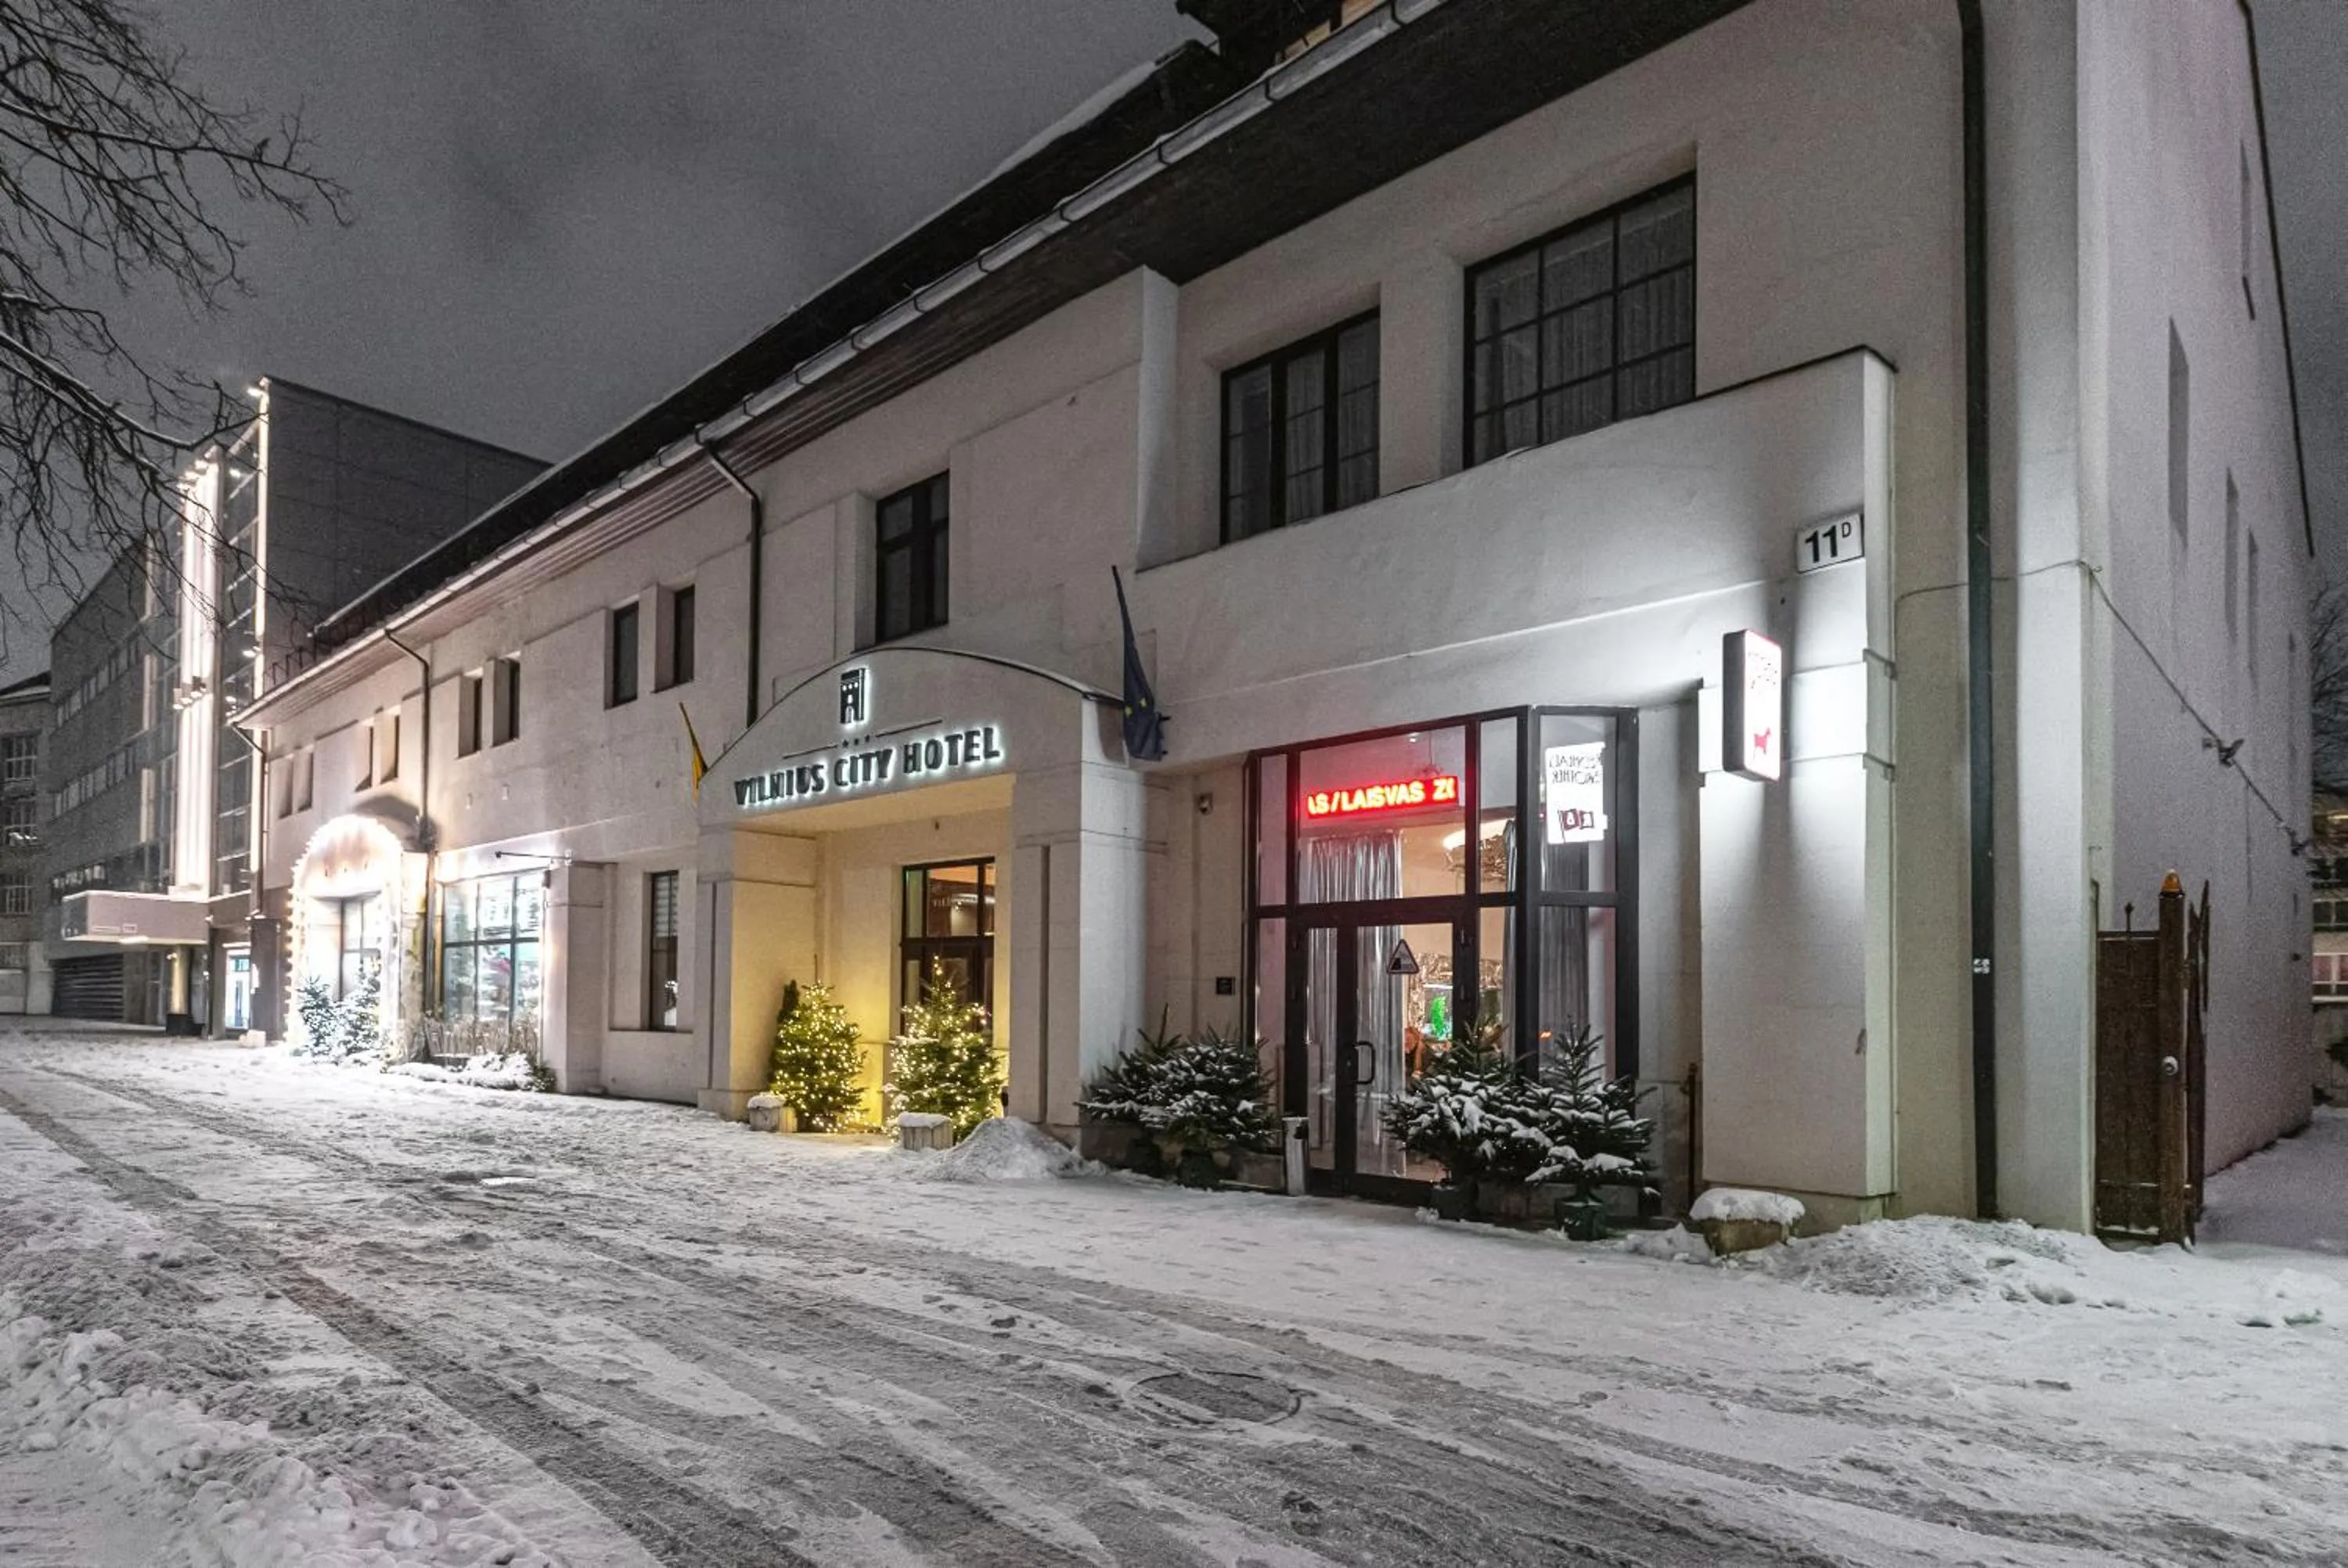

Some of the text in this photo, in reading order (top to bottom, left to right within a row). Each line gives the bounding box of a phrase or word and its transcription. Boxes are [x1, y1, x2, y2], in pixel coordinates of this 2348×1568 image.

[734, 727, 1000, 805] VILNIUS CITY HOTEL
